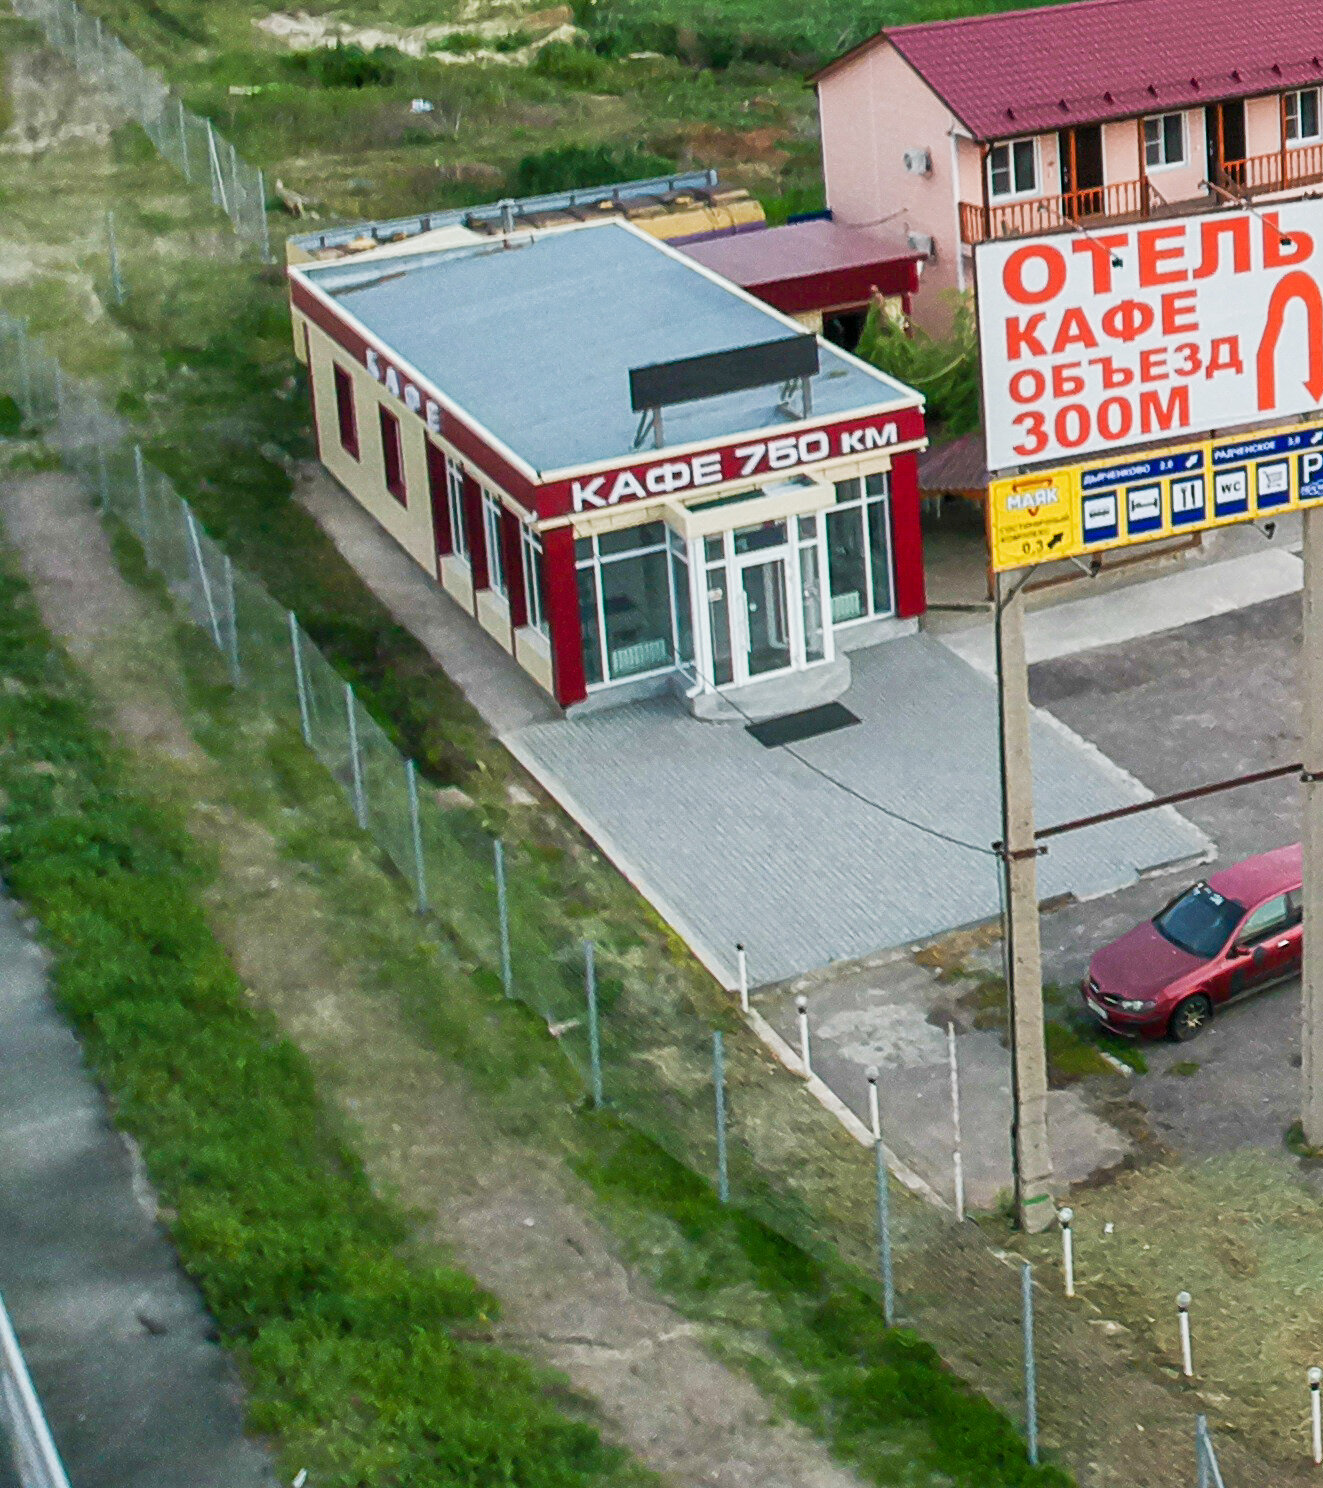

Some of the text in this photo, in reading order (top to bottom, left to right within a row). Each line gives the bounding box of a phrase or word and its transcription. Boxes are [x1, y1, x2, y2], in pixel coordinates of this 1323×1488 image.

[1002, 212, 1314, 305] ОТЕЛЬ
[1005, 289, 1199, 361] КАФЕ
[1008, 335, 1243, 404] ОБЪЕЗД
[1012, 385, 1190, 456] 300М
[572, 453, 722, 512] КАФЕ
[1006, 487, 1058, 511] МАЯК
[1221, 481, 1242, 493] WC
